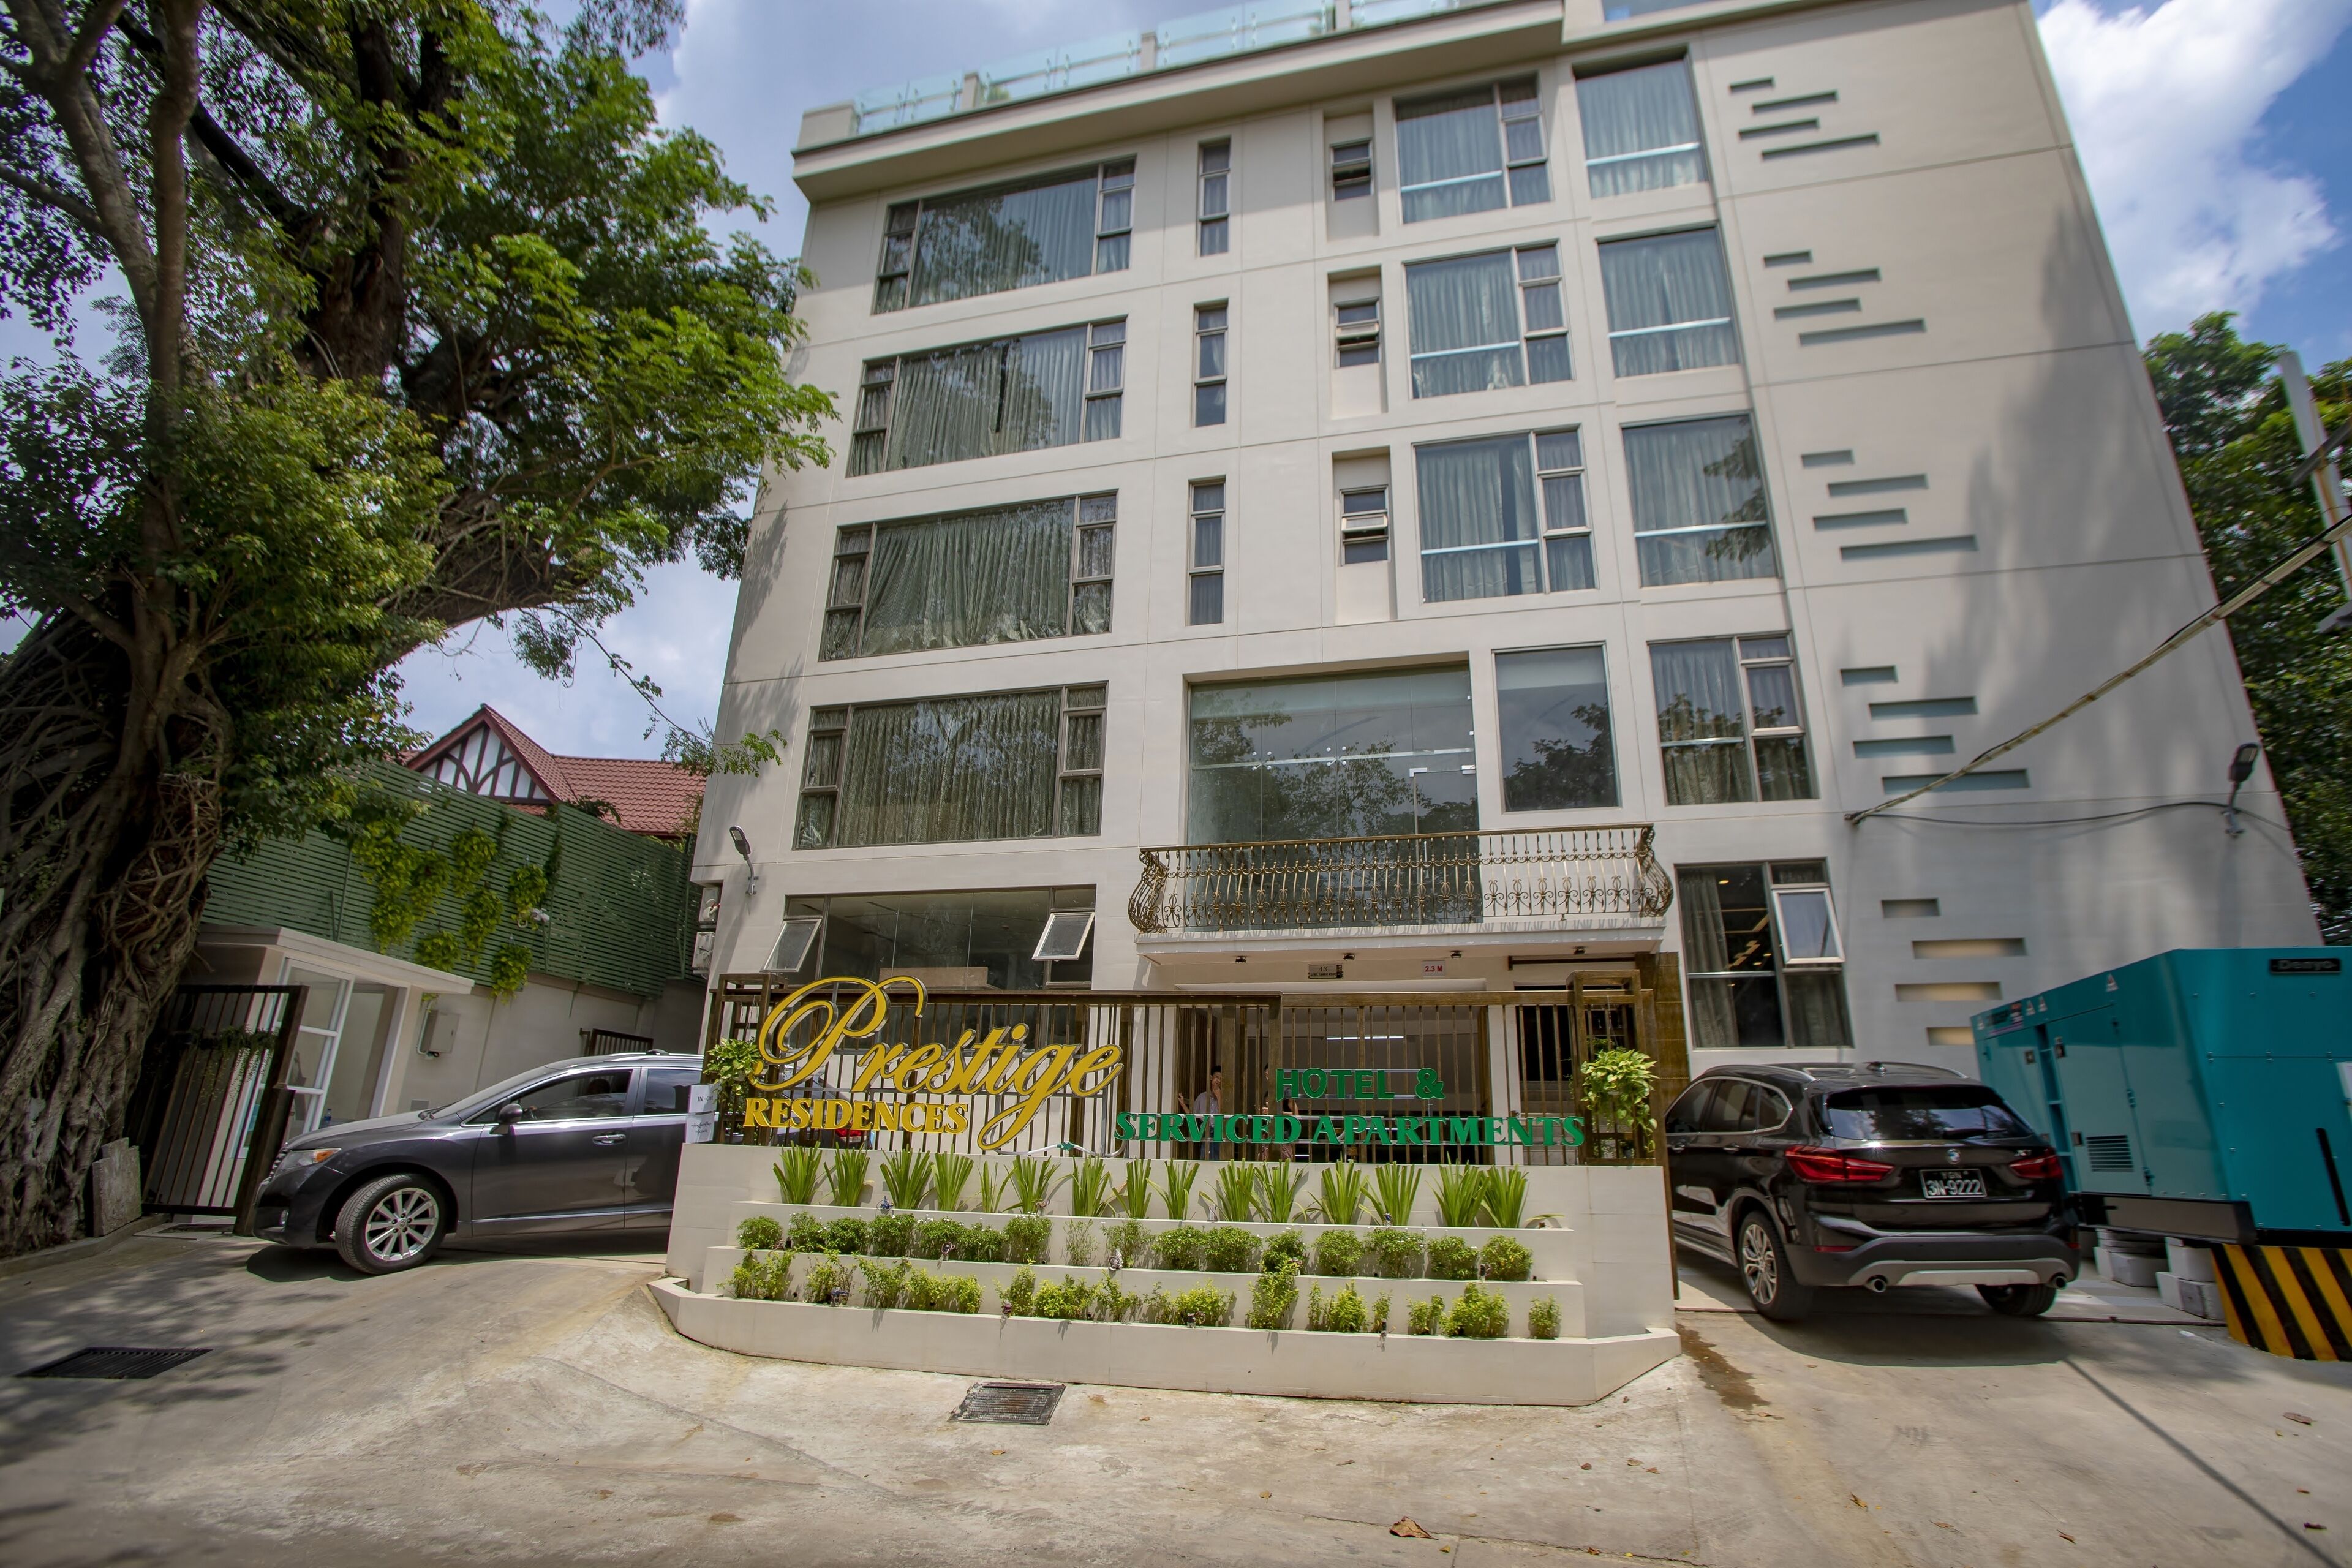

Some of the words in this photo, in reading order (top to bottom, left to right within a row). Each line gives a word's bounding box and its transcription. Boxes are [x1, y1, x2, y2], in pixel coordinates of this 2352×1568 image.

[748, 976, 1124, 1152] Prestige
[1276, 1068, 1395, 1100] HOTEL
[1414, 1068, 1445, 1100] &
[743, 1097, 969, 1134] RESIDENCES
[1114, 1111, 1302, 1144] SERVICED
[1311, 1114, 1585, 1147] APARTMENTS
[1926, 1179, 1983, 1196] 3N-9222
